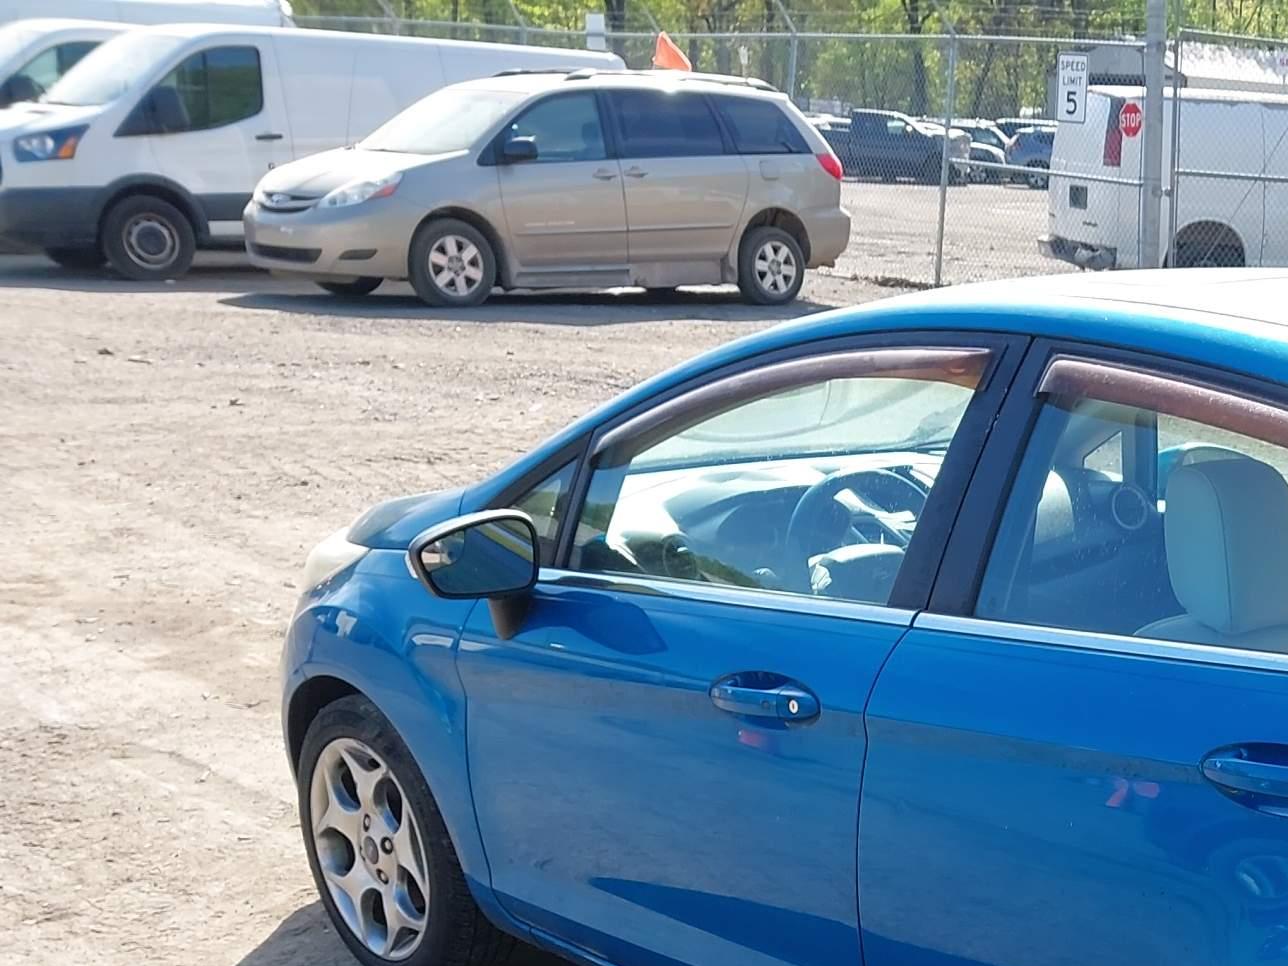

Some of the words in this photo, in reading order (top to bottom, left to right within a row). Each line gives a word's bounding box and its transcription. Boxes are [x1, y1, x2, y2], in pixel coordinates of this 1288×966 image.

[1061, 60, 1085, 72] SPEED
[1062, 76, 1082, 86] LIMIT
[1066, 91, 1078, 115] 5
[1121, 112, 1141, 127] STOP
